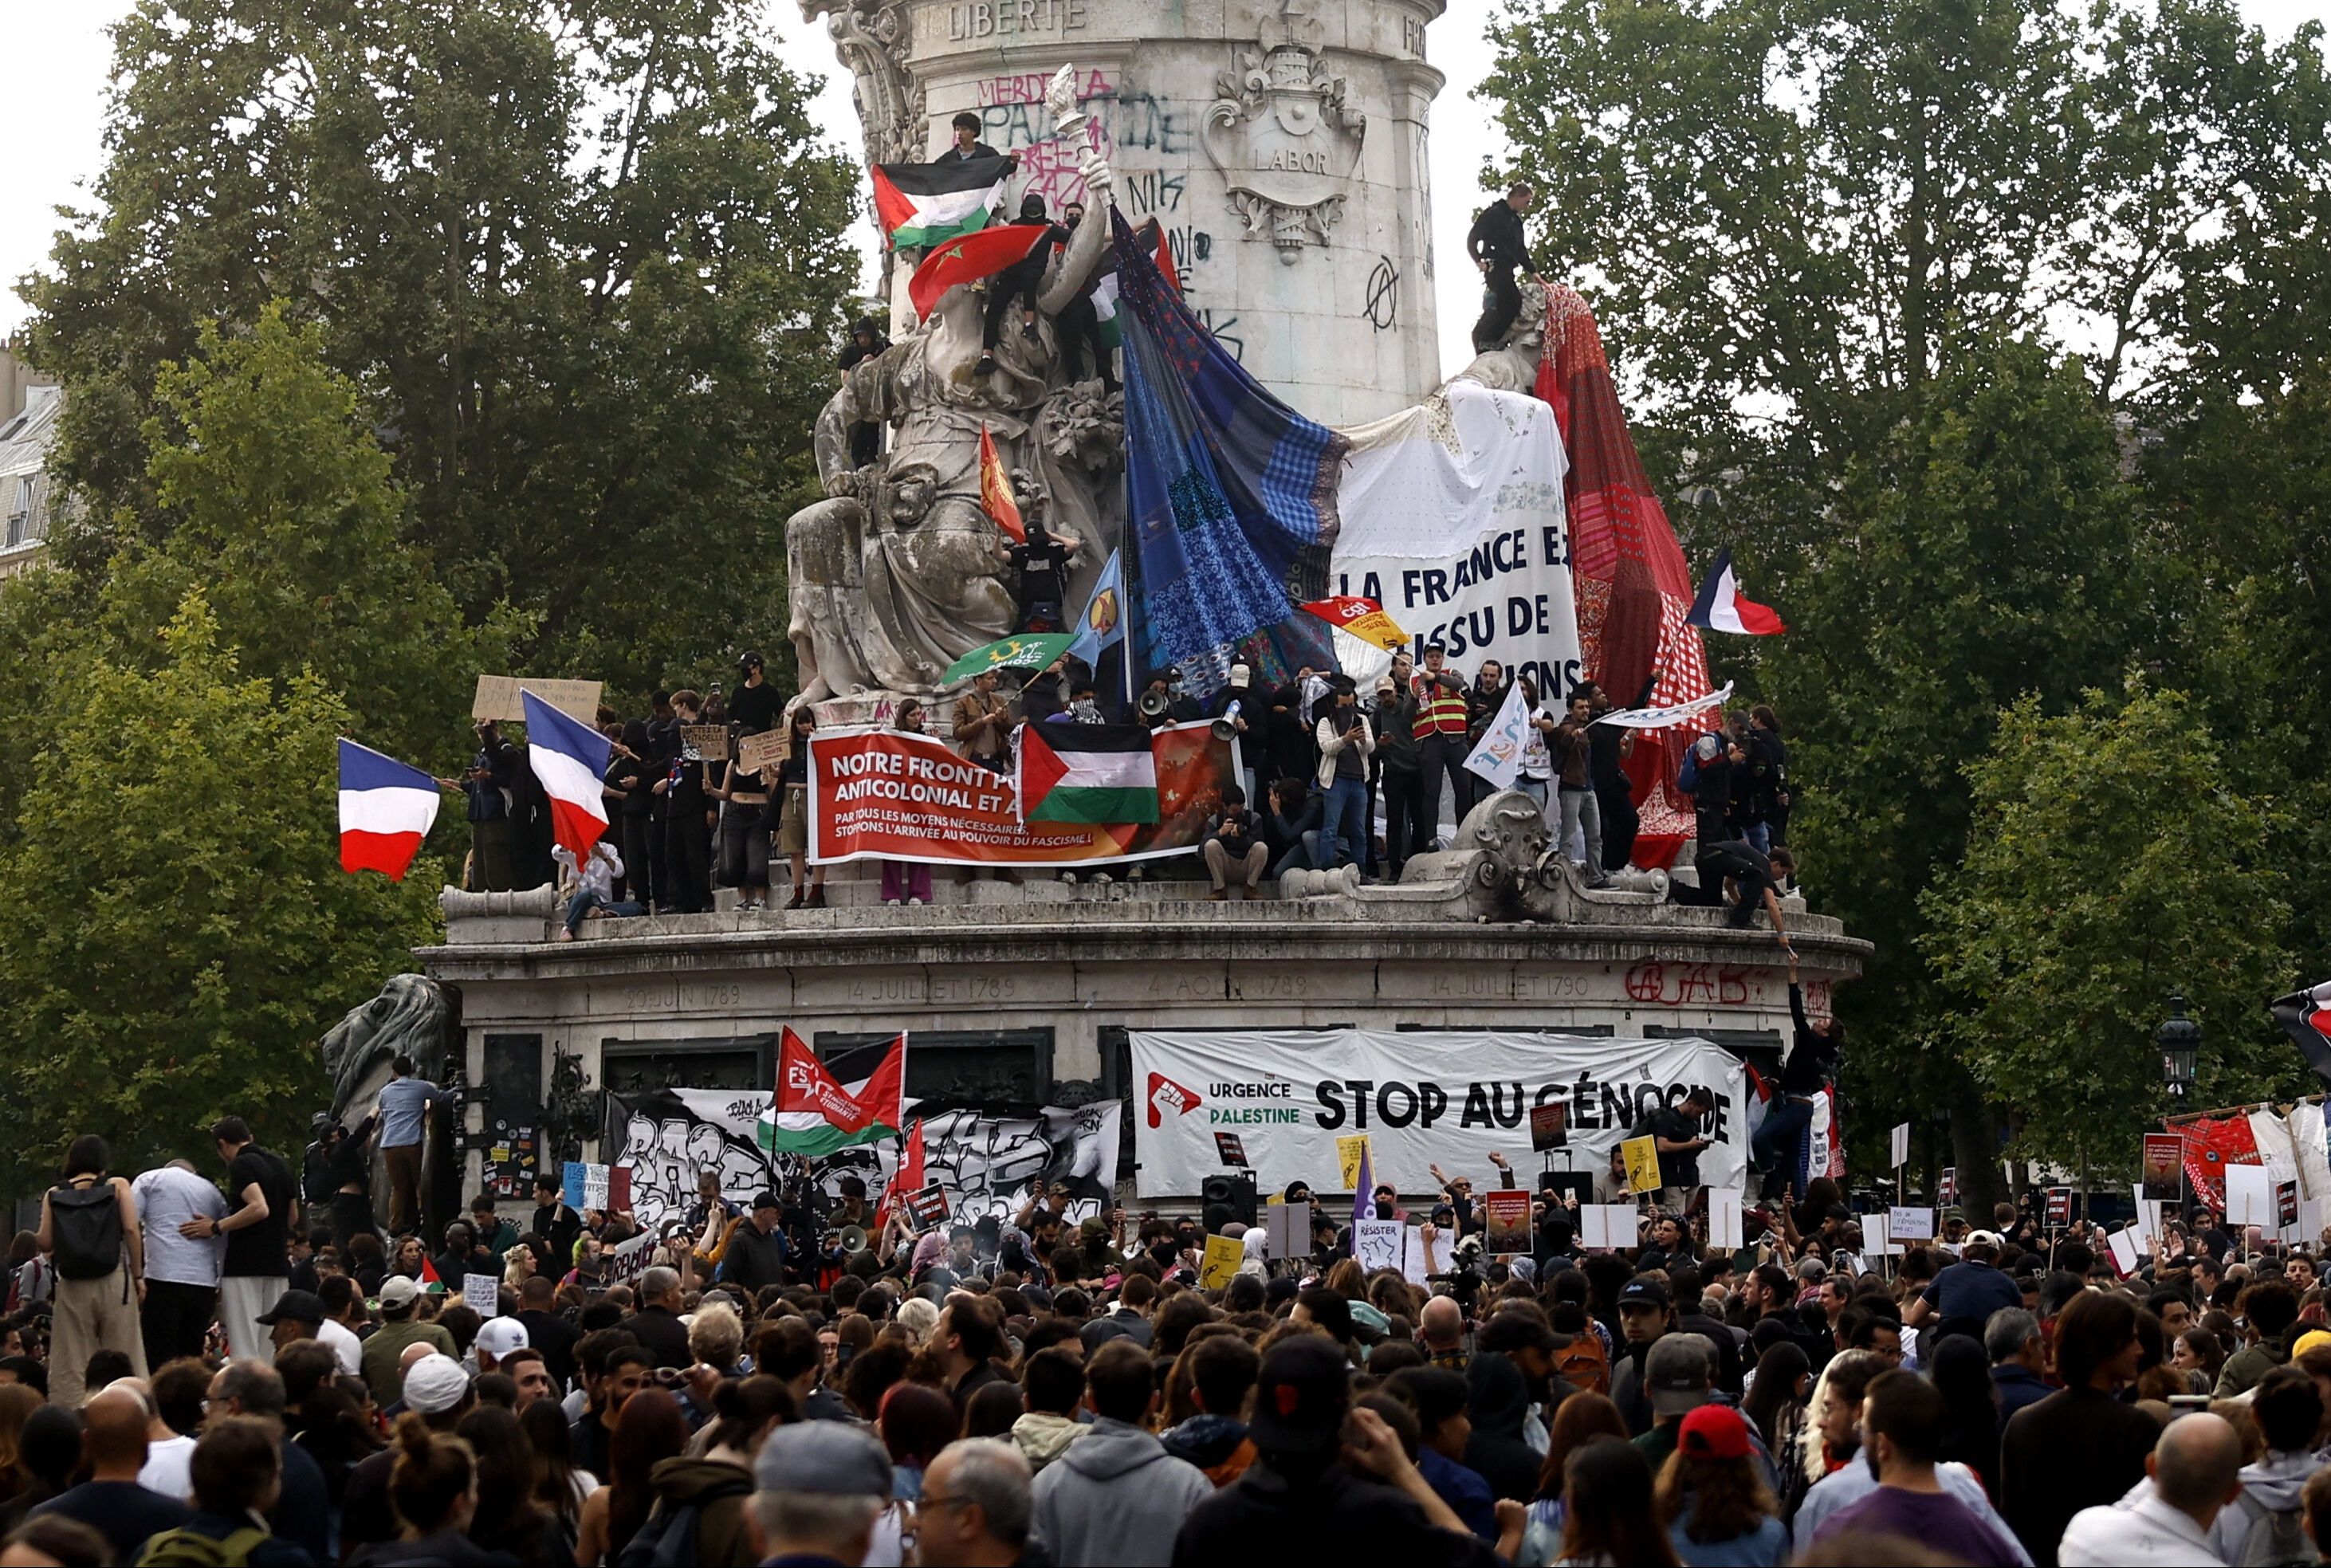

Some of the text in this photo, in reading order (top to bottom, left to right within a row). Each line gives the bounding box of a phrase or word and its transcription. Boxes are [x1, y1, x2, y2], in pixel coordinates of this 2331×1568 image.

[1256, 148, 1326, 175] LABOR
[1127, 169, 1185, 216] NIK
[1401, 529, 1527, 607] FRANCE
[1341, 600, 1371, 619] cgt
[1507, 594, 1550, 638] DE
[831, 753, 902, 778] NOTRE
[908, 756, 989, 788] FRONT
[835, 778, 973, 810] ANTICOLONIAL
[977, 794, 1003, 812] ET
[835, 813, 855, 824] PAR
[855, 808, 880, 821] TOUS
[881, 810, 899, 821] LES
[901, 812, 949, 827] MOYENS
[835, 820, 884, 838] STOPPONS
[886, 823, 941, 839] L'ARRIVÉE
[941, 830, 957, 840] AU
[959, 831, 1011, 845] POUVOIR
[1013, 835, 1028, 847] DU
[1032, 834, 1086, 847] FASCISME
[704, 985, 741, 1006] 1789
[847, 978, 1016, 1000] 14 JUILLET 1789
[1260, 976, 1307, 996] 1789
[1460, 975, 1539, 996] JUILLET
[1547, 976, 1589, 996] 1790
[1209, 1083, 1291, 1098] URGENCE
[1210, 1108, 1300, 1124] PALESTINE
[1315, 1080, 1449, 1130] STOP
[1460, 1082, 1524, 1129] AU
